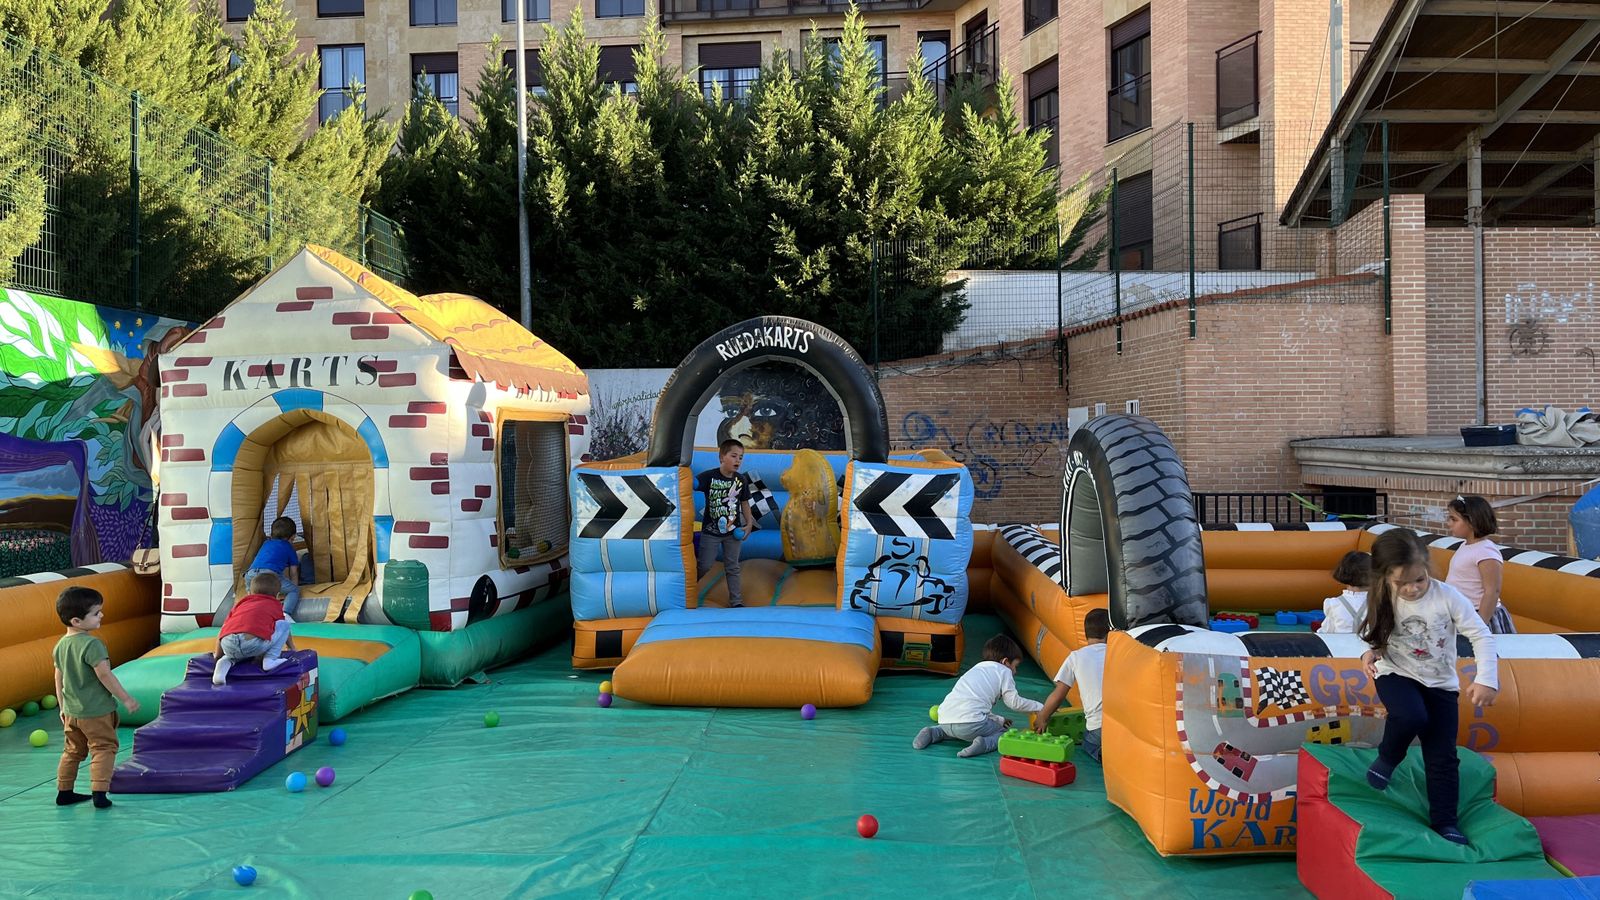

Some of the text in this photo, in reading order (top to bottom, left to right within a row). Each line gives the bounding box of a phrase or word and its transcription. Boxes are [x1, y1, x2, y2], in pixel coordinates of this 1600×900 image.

[715, 326, 815, 361] RUEDAKARTS
[222, 355, 379, 391] KARTS
[1189, 788, 1272, 821] World
[1190, 818, 1297, 850] KAR
